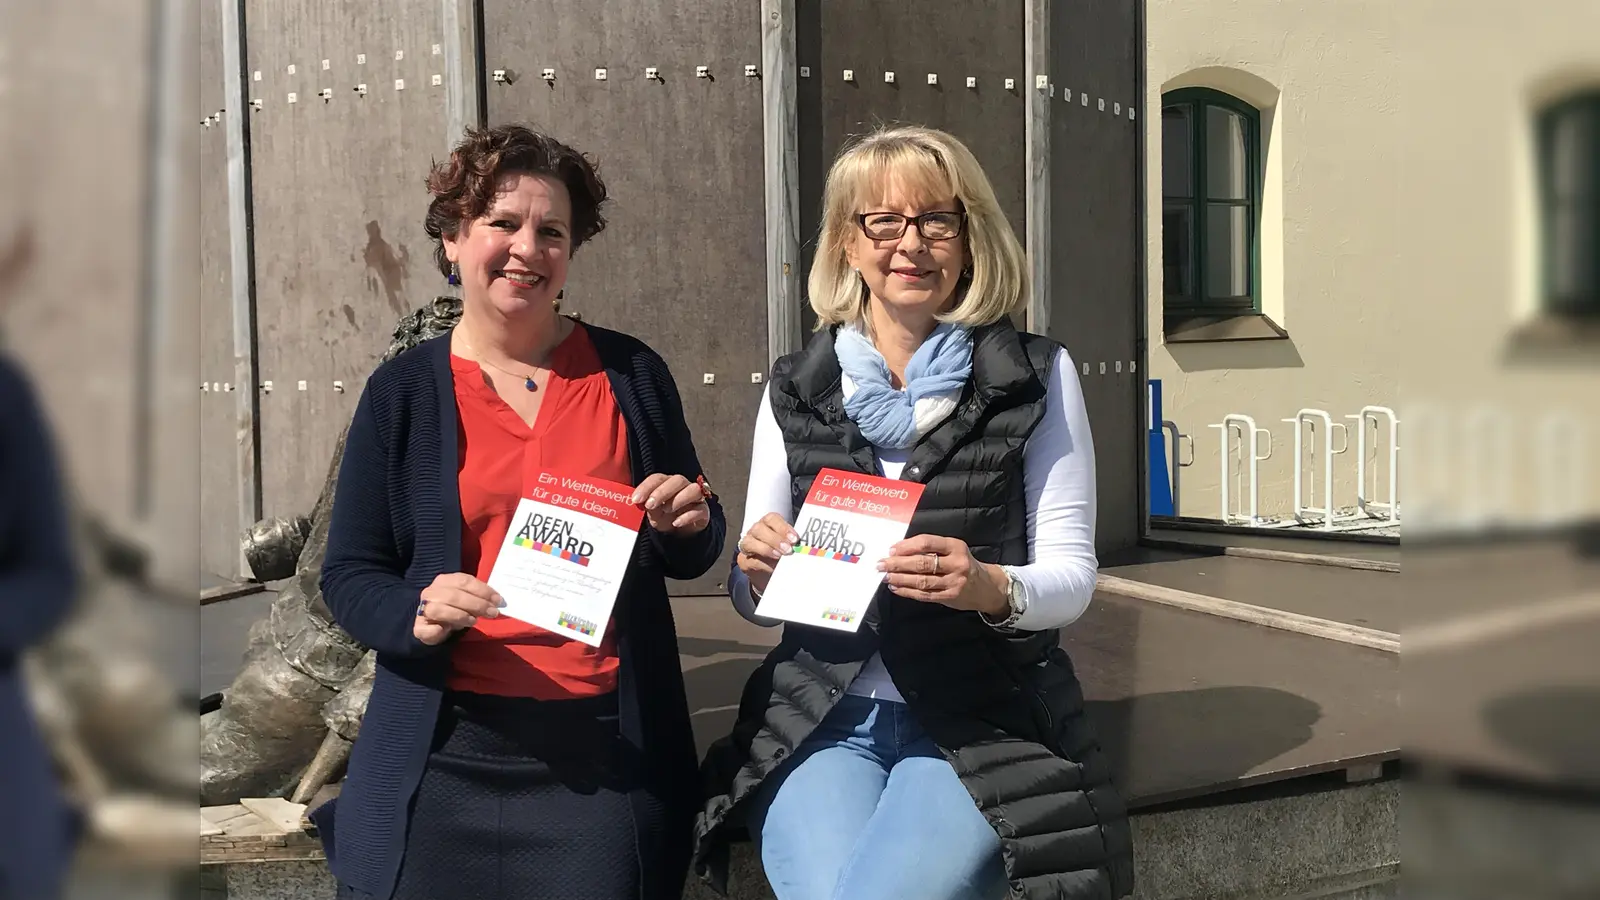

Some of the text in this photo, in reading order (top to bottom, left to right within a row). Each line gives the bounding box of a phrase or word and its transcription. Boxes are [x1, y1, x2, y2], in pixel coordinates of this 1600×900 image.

[538, 472, 634, 507] Ein Wettbewerb
[821, 474, 908, 500] Ein Wettbewerb
[532, 486, 619, 520] für gute Ideen.
[814, 489, 891, 516] für gute Ideen.
[525, 512, 574, 537] IDEEN
[804, 516, 849, 539] IDEEN
[516, 525, 594, 558] AWARD
[795, 531, 865, 557] AWARD
